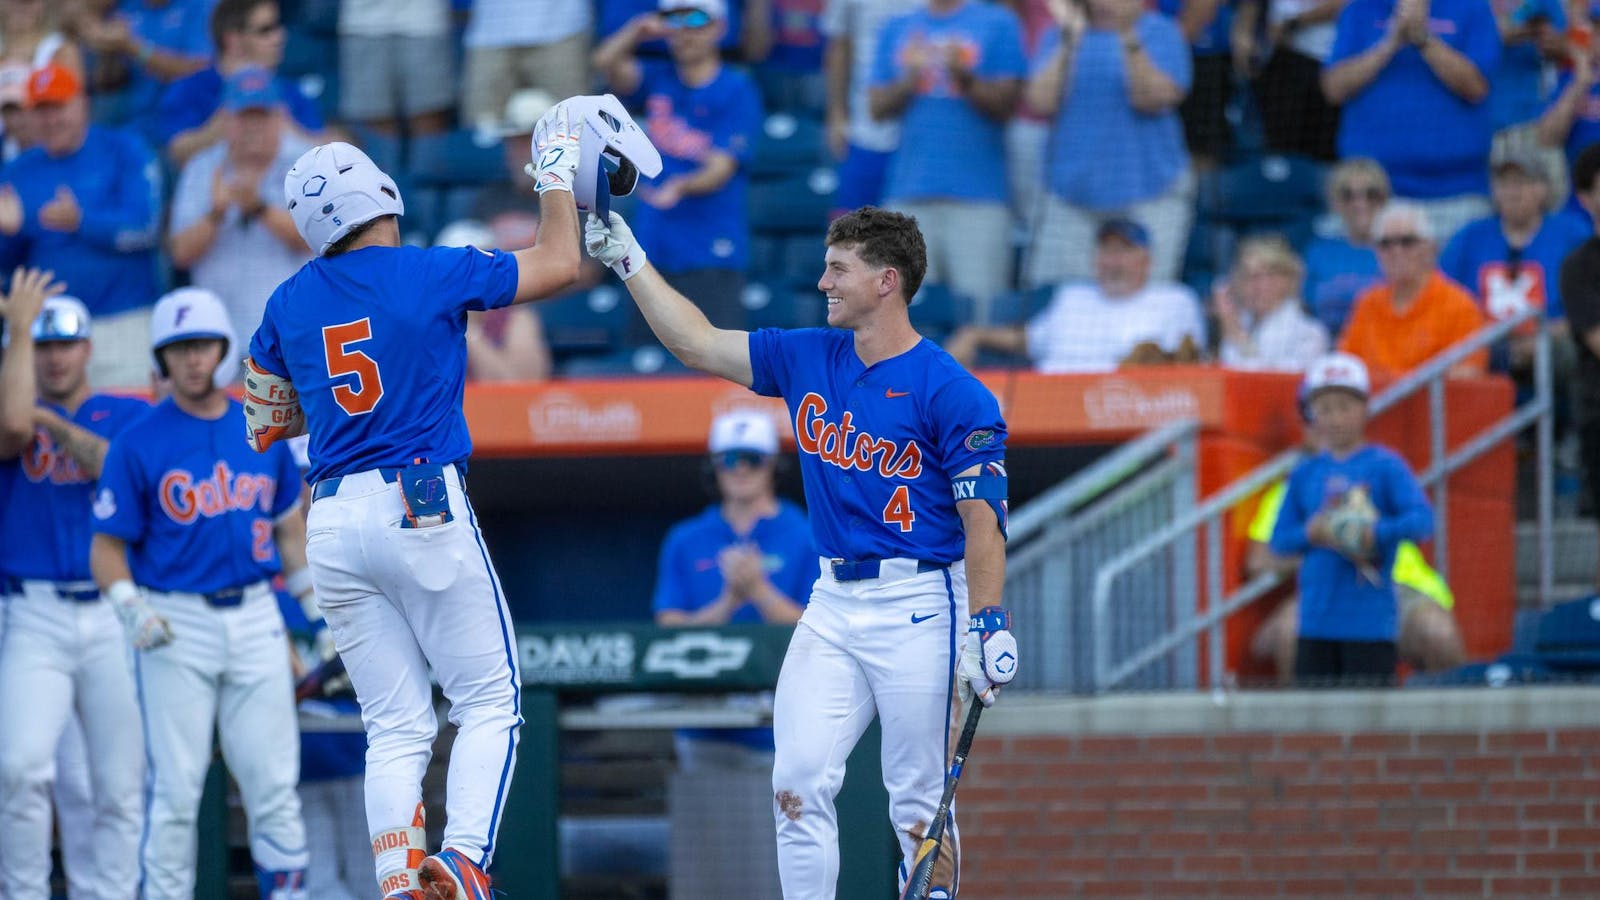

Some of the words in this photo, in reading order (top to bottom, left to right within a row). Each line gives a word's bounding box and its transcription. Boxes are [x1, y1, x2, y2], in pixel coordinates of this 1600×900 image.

[332, 217, 342, 226] 5
[620, 255, 632, 275] F
[173, 304, 192, 327] F
[322, 317, 384, 416] 5
[796, 392, 922, 479] Gators
[425, 478, 438, 502] F
[882, 485, 915, 532] 4
[251, 518, 274, 562] 2
[968, 617, 985, 629] FO
[519, 634, 634, 668] DAVIS
